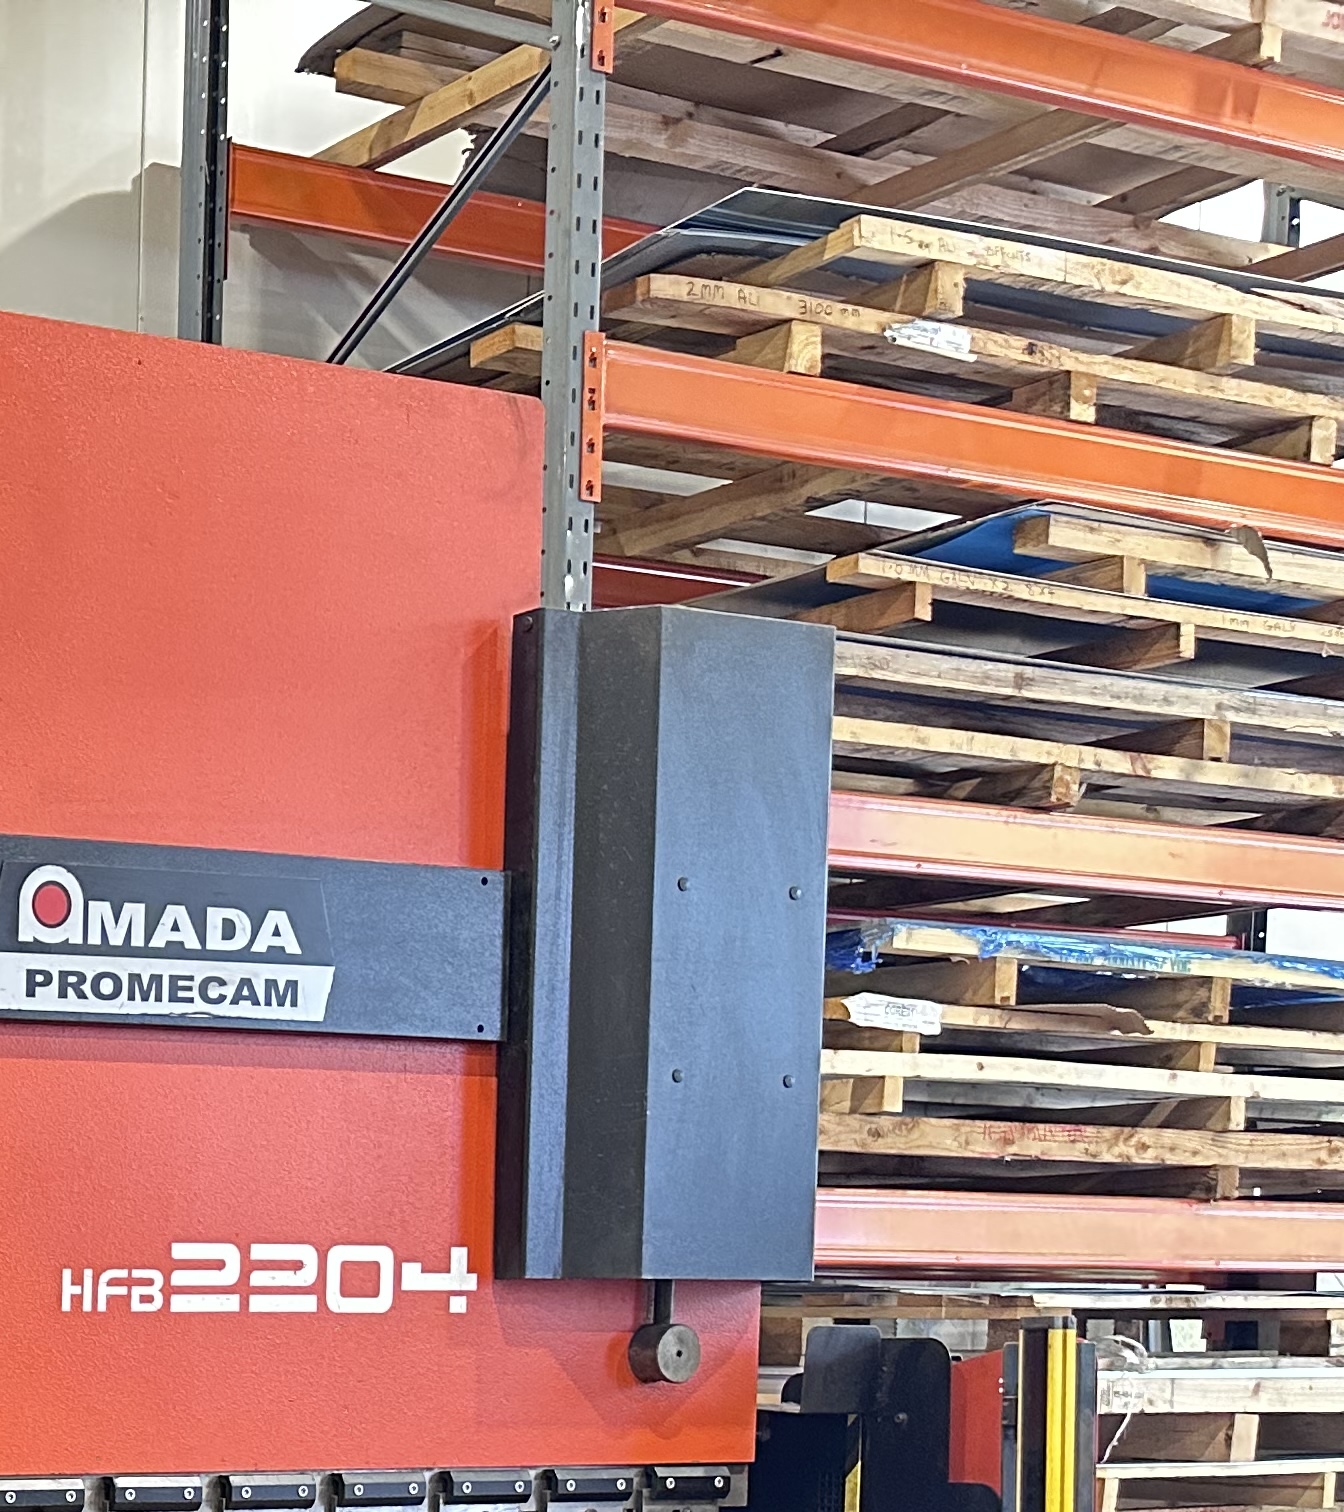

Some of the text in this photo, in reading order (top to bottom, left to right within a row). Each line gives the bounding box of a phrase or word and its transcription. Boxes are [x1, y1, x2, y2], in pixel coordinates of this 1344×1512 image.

[798, 299, 833, 316] 3100
[17, 863, 303, 955] AMADA
[24, 967, 300, 1008] PROMECAM
